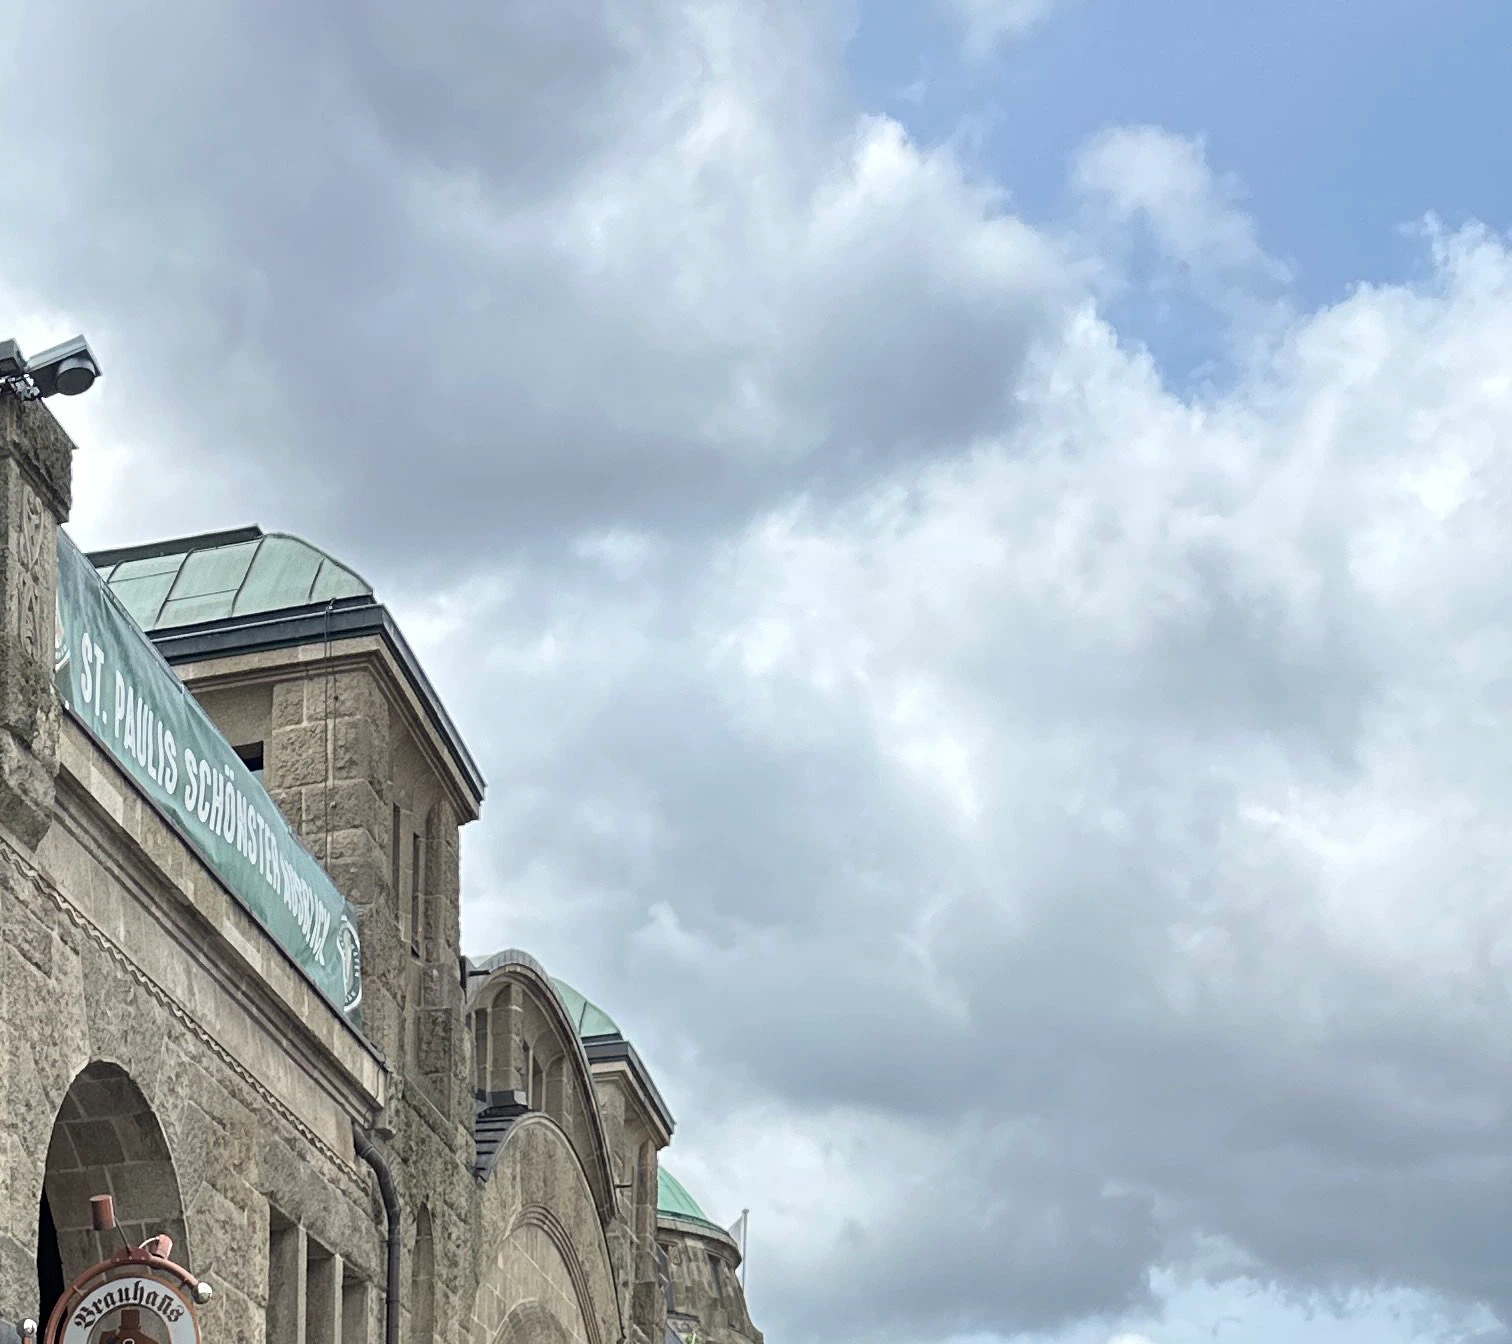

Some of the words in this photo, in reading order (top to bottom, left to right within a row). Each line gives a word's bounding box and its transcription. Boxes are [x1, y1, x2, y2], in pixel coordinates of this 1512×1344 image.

[81, 632, 108, 725] ST.
[114, 669, 178, 795] PAULIS
[184, 748, 281, 895] SCHÖNSTER
